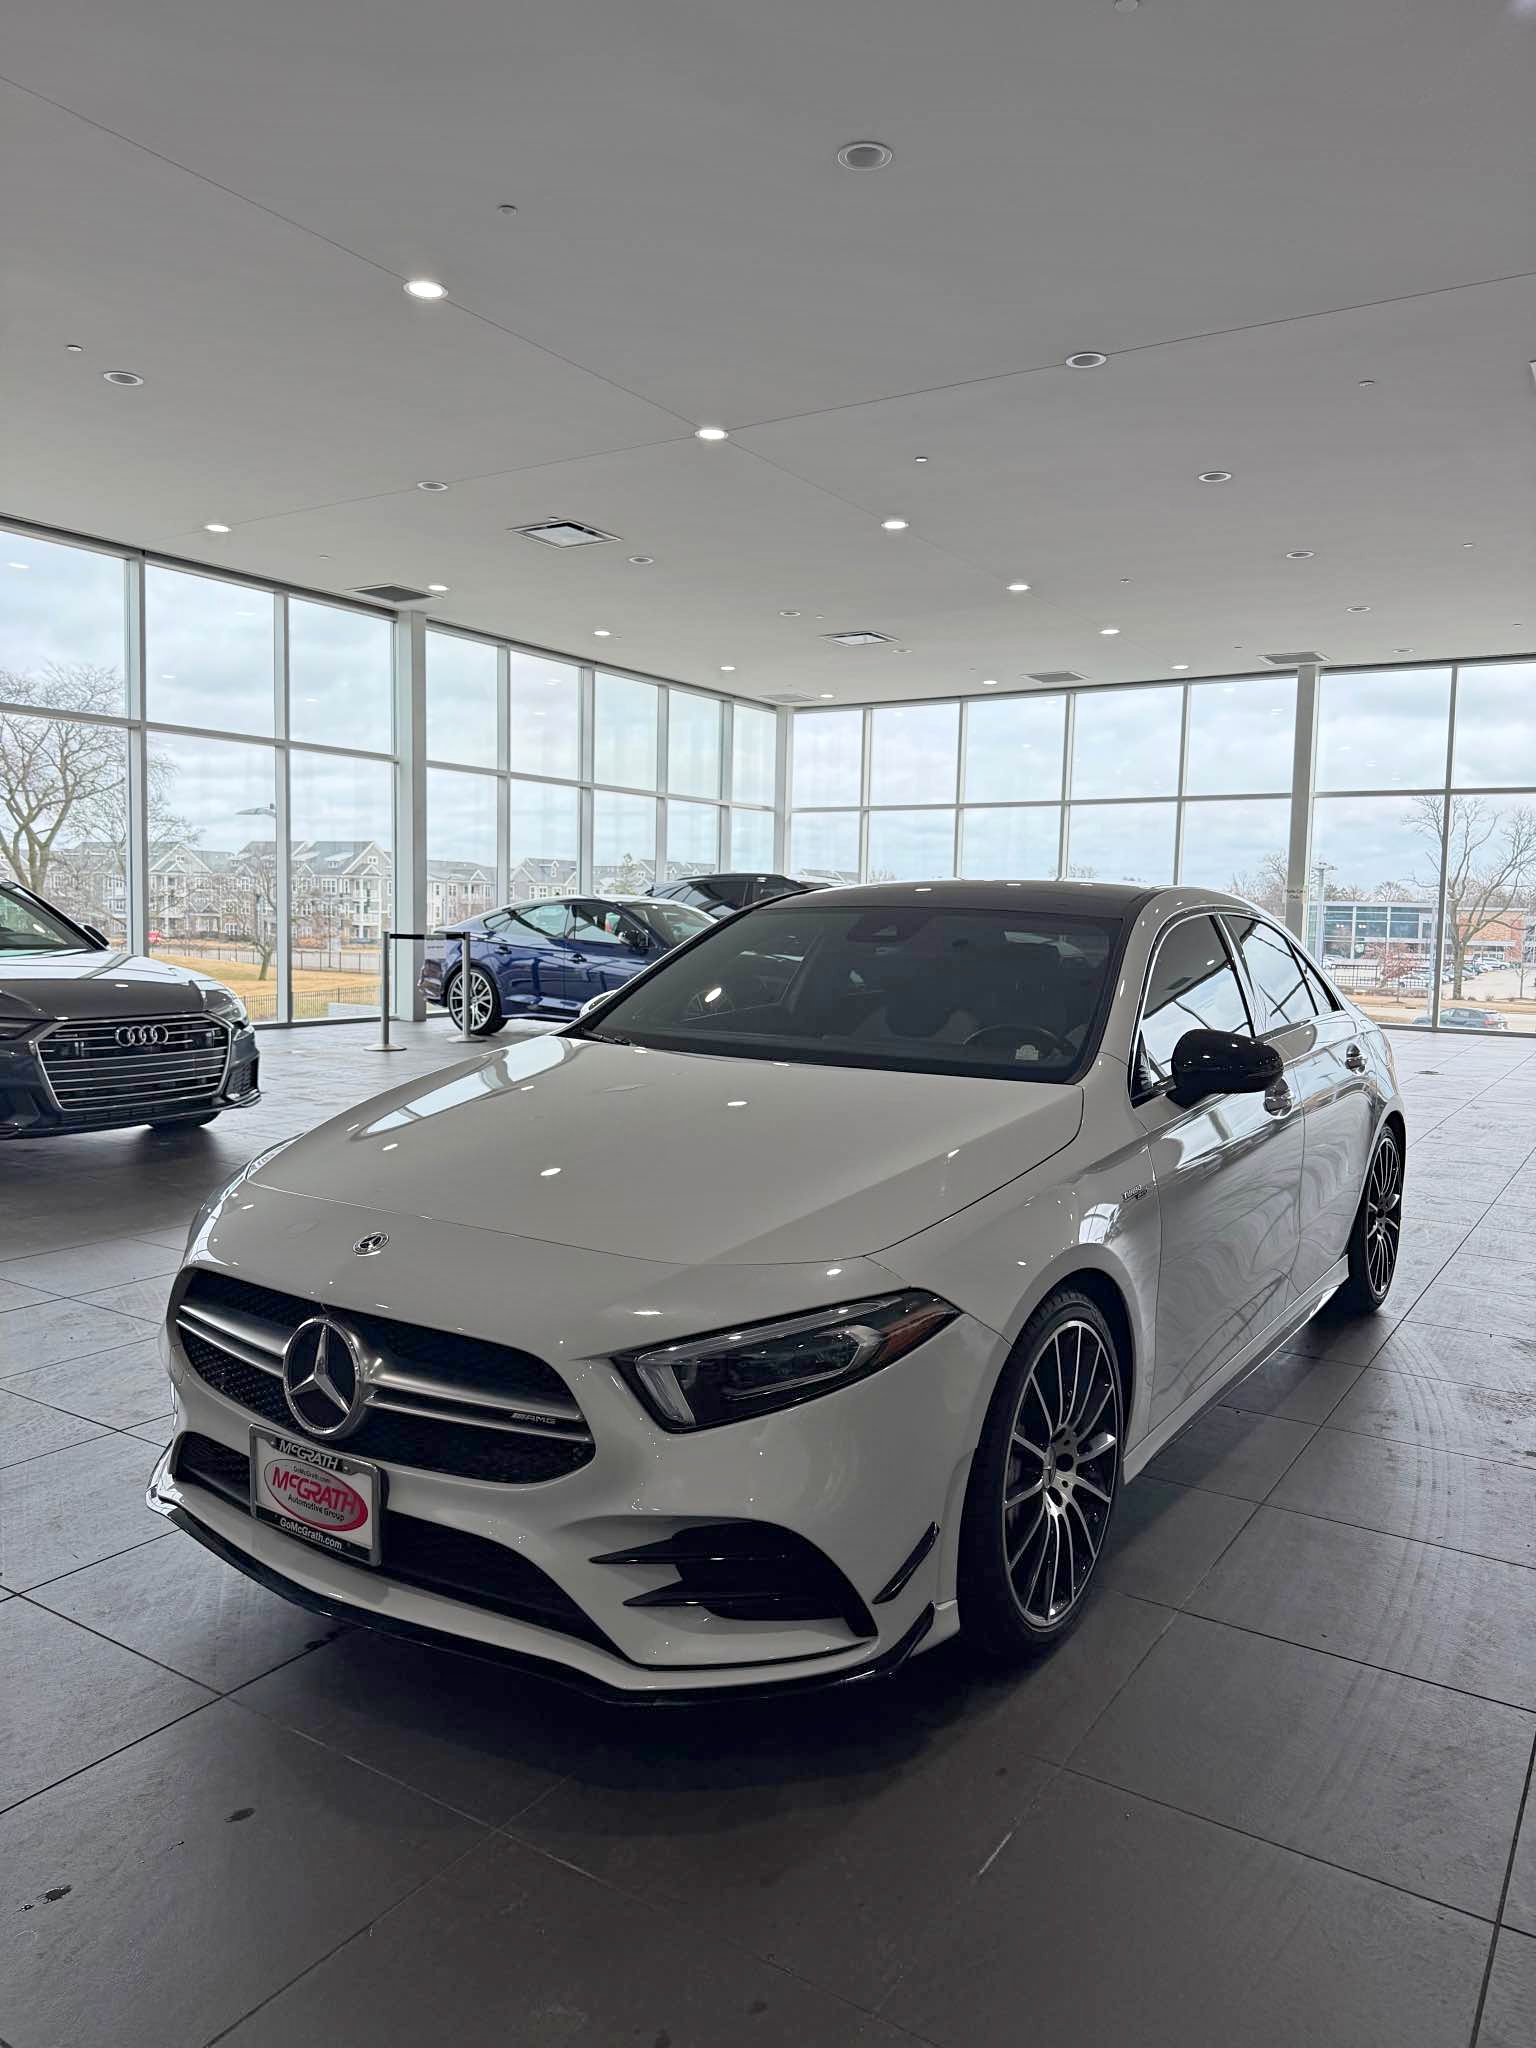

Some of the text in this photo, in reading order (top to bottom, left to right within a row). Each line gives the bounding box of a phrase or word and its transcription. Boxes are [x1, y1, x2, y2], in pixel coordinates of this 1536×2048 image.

[287, 1495, 345, 1522] Automotive Group
[280, 1517, 342, 1550] GoMcGrath.com
